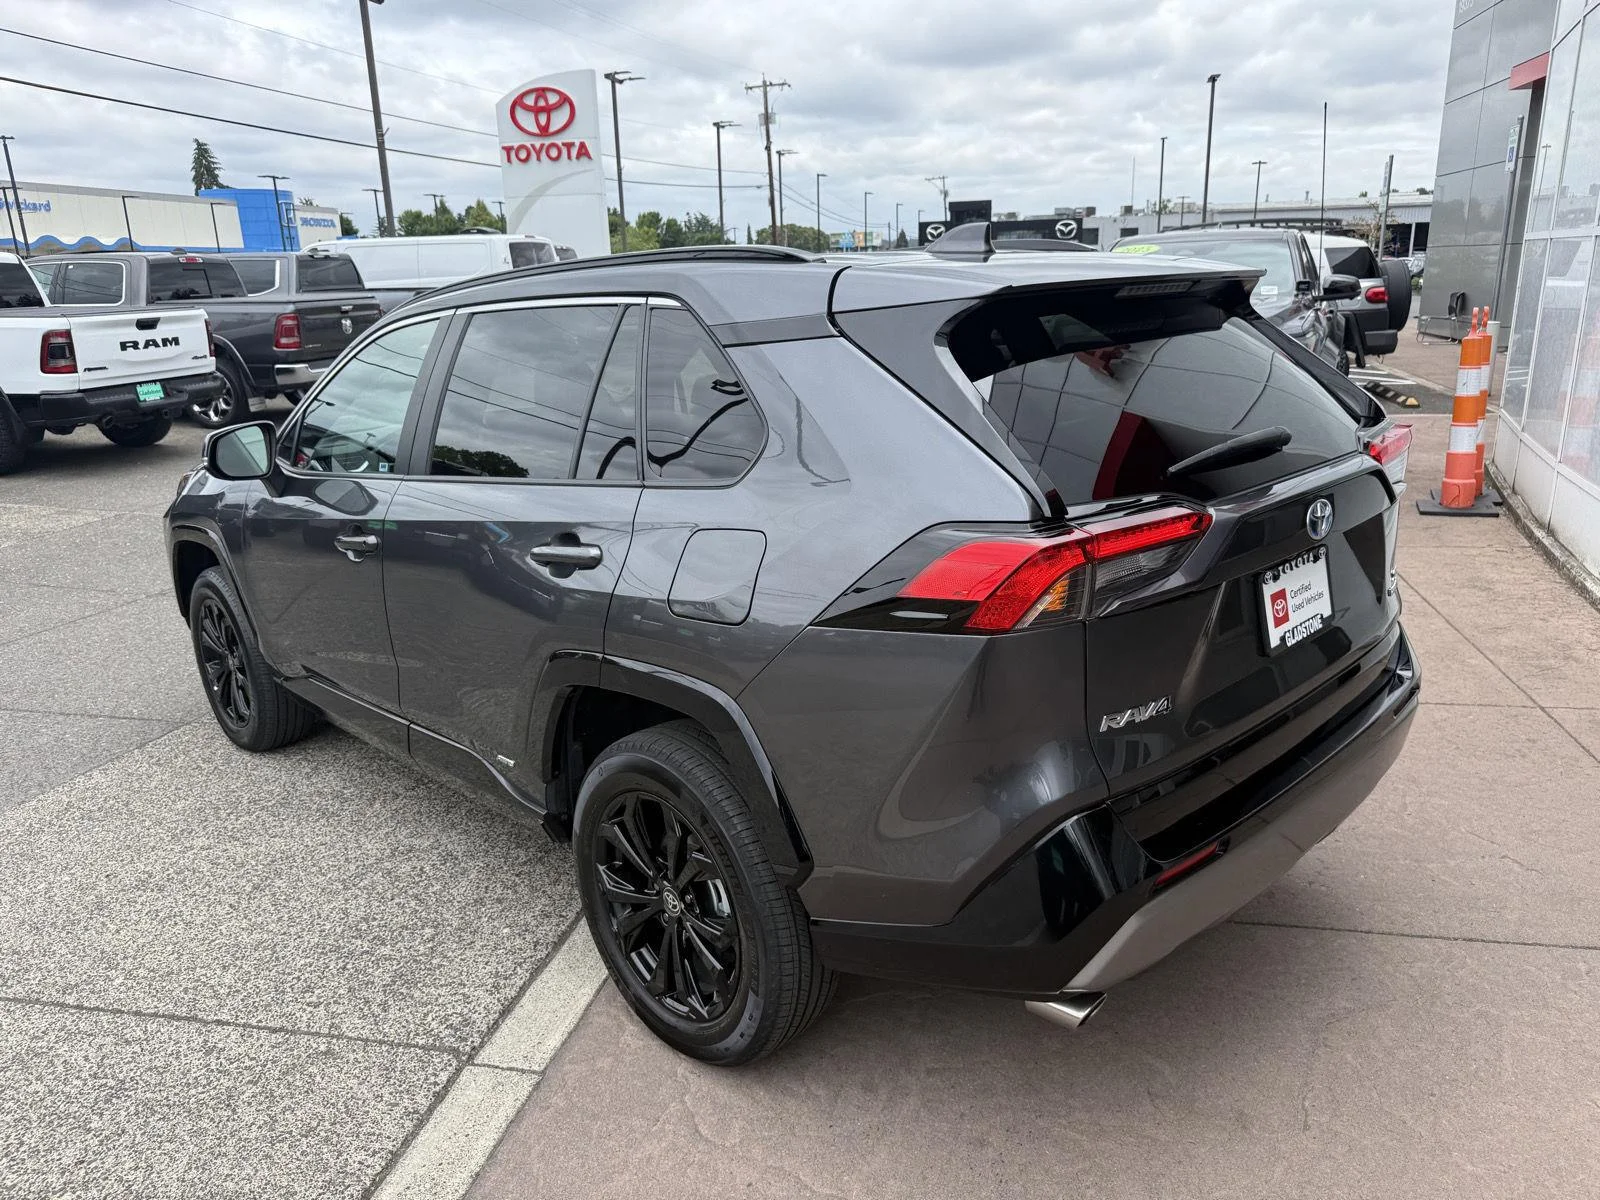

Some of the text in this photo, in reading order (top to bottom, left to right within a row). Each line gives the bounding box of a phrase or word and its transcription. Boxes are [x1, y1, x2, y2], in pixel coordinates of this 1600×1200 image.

[501, 141, 593, 165] TOYOTA
[300, 217, 337, 229] HONDA
[120, 336, 180, 351] RAM
[1278, 552, 1315, 576] TOYOTA
[1290, 581, 1312, 598] Certified
[1291, 591, 1324, 613] Used Vehicles
[1285, 615, 1323, 647] GLADSTONE
[1100, 695, 1172, 732] RAV4
